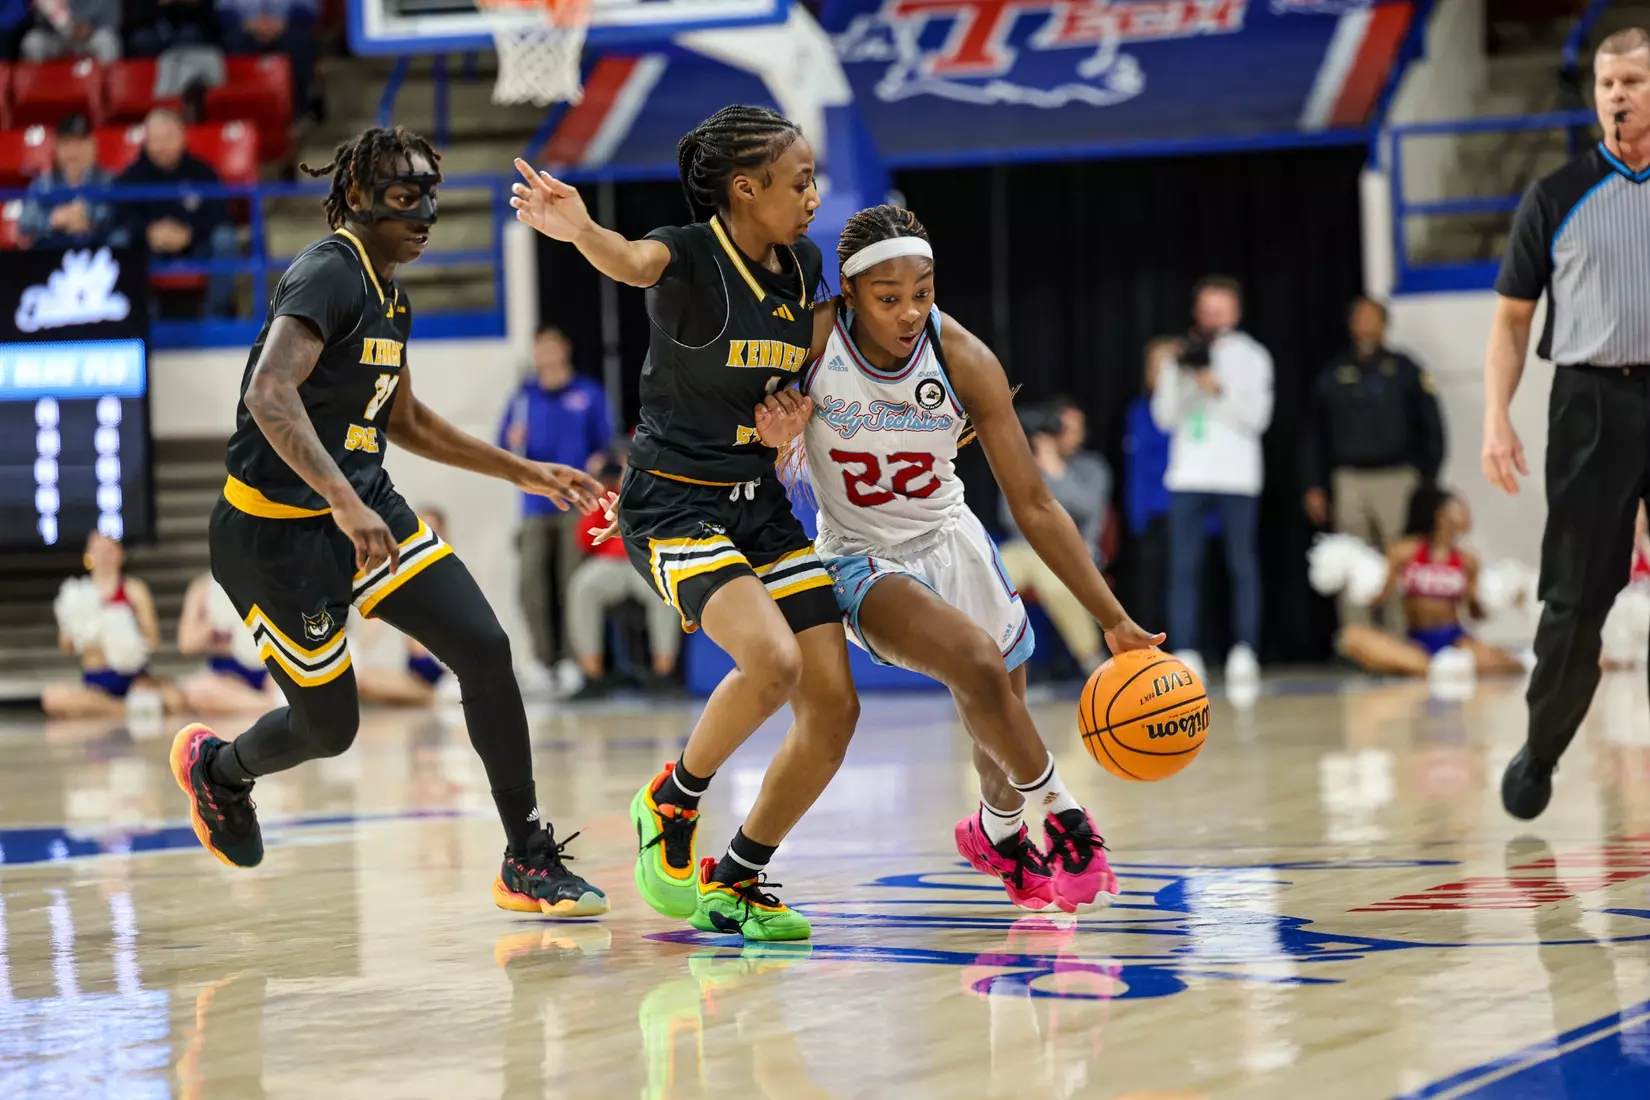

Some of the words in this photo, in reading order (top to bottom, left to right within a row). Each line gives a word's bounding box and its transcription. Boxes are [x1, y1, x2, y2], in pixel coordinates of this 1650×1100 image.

[725, 339, 810, 373] KENNES
[815, 394, 862, 440] Lady
[863, 400, 953, 433] Techsters
[828, 448, 942, 508] 22
[1146, 703, 1210, 739] Wilson
